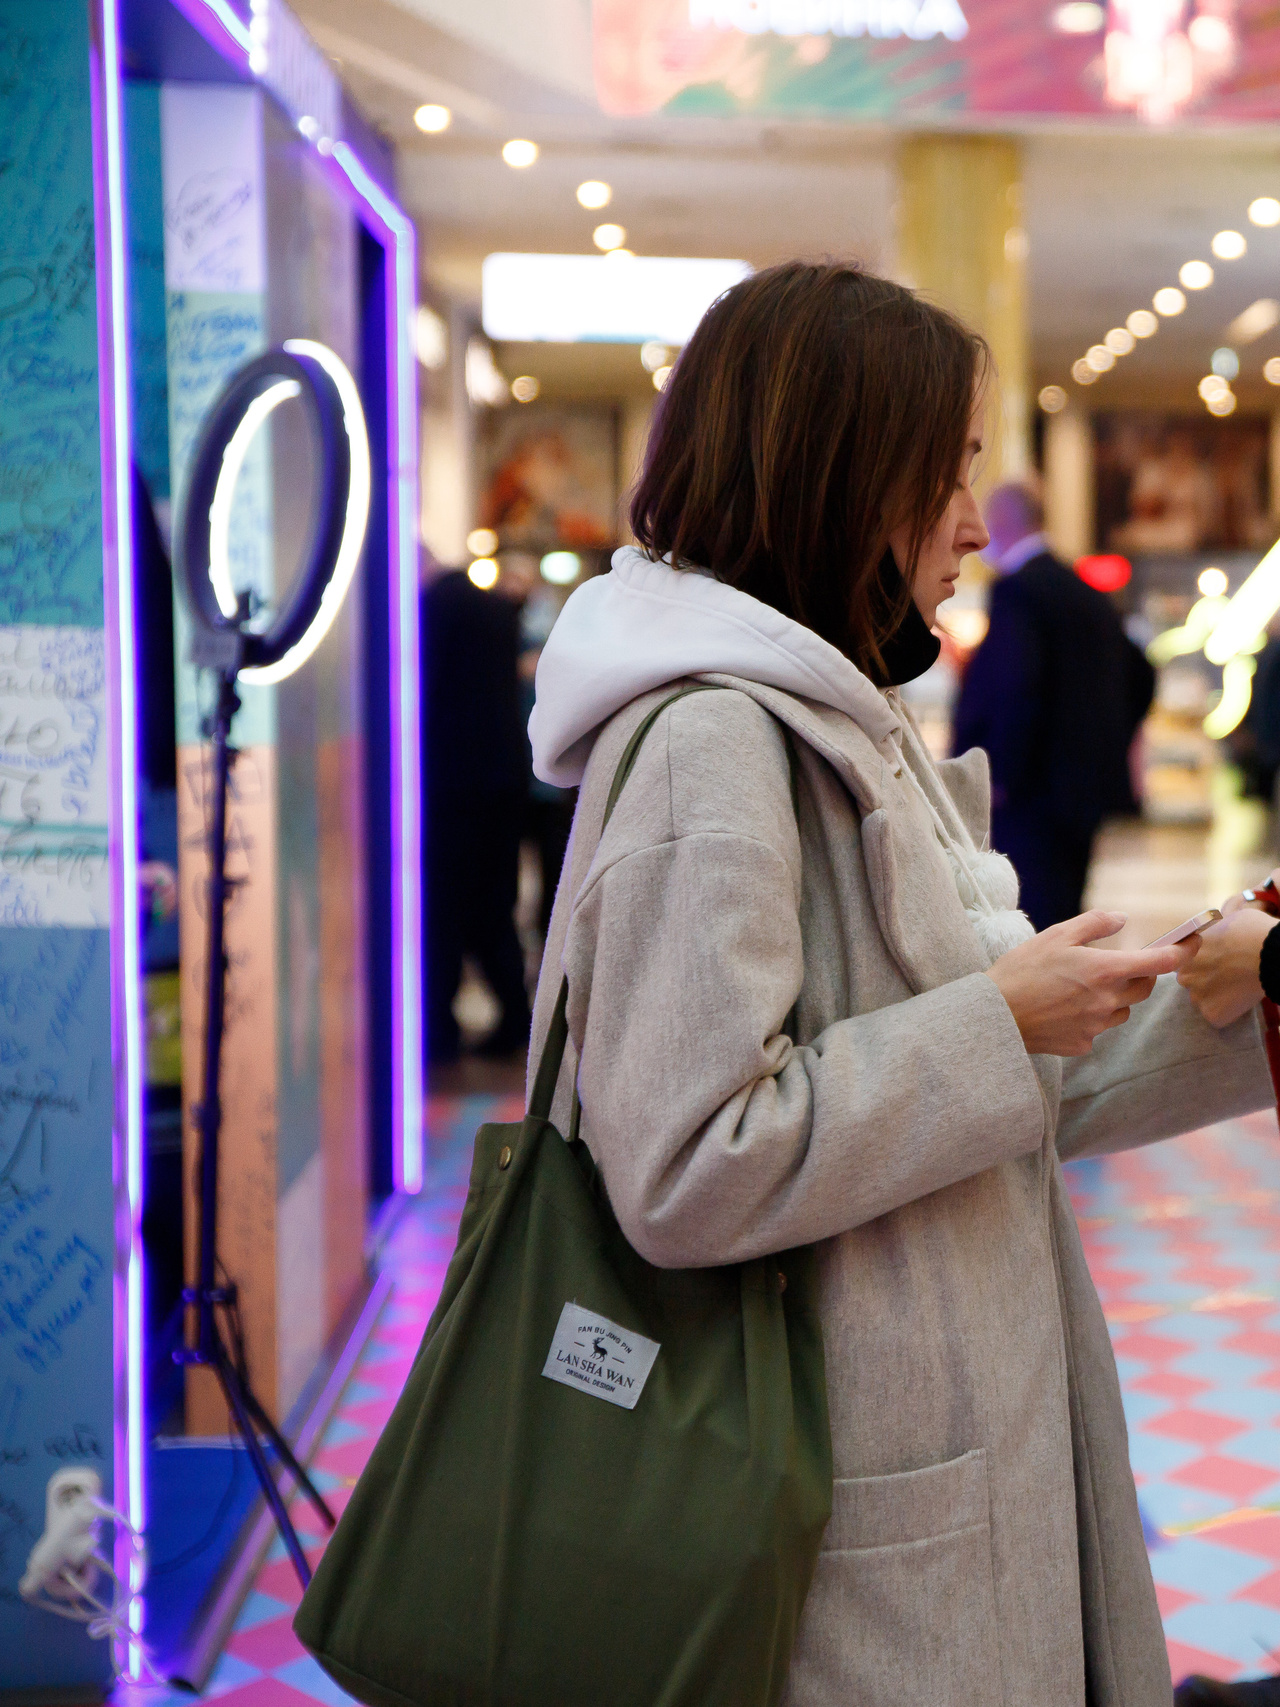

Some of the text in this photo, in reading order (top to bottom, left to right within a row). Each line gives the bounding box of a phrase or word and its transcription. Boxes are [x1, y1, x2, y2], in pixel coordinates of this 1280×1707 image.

[594, 1327, 605, 1335] BU
[605, 1332, 621, 1344] JING
[620, 1342, 633, 1354] PIN
[556, 1349, 635, 1389] LAN SHA WAN
[565, 1368, 616, 1393] ORIGINAL DESIGN
